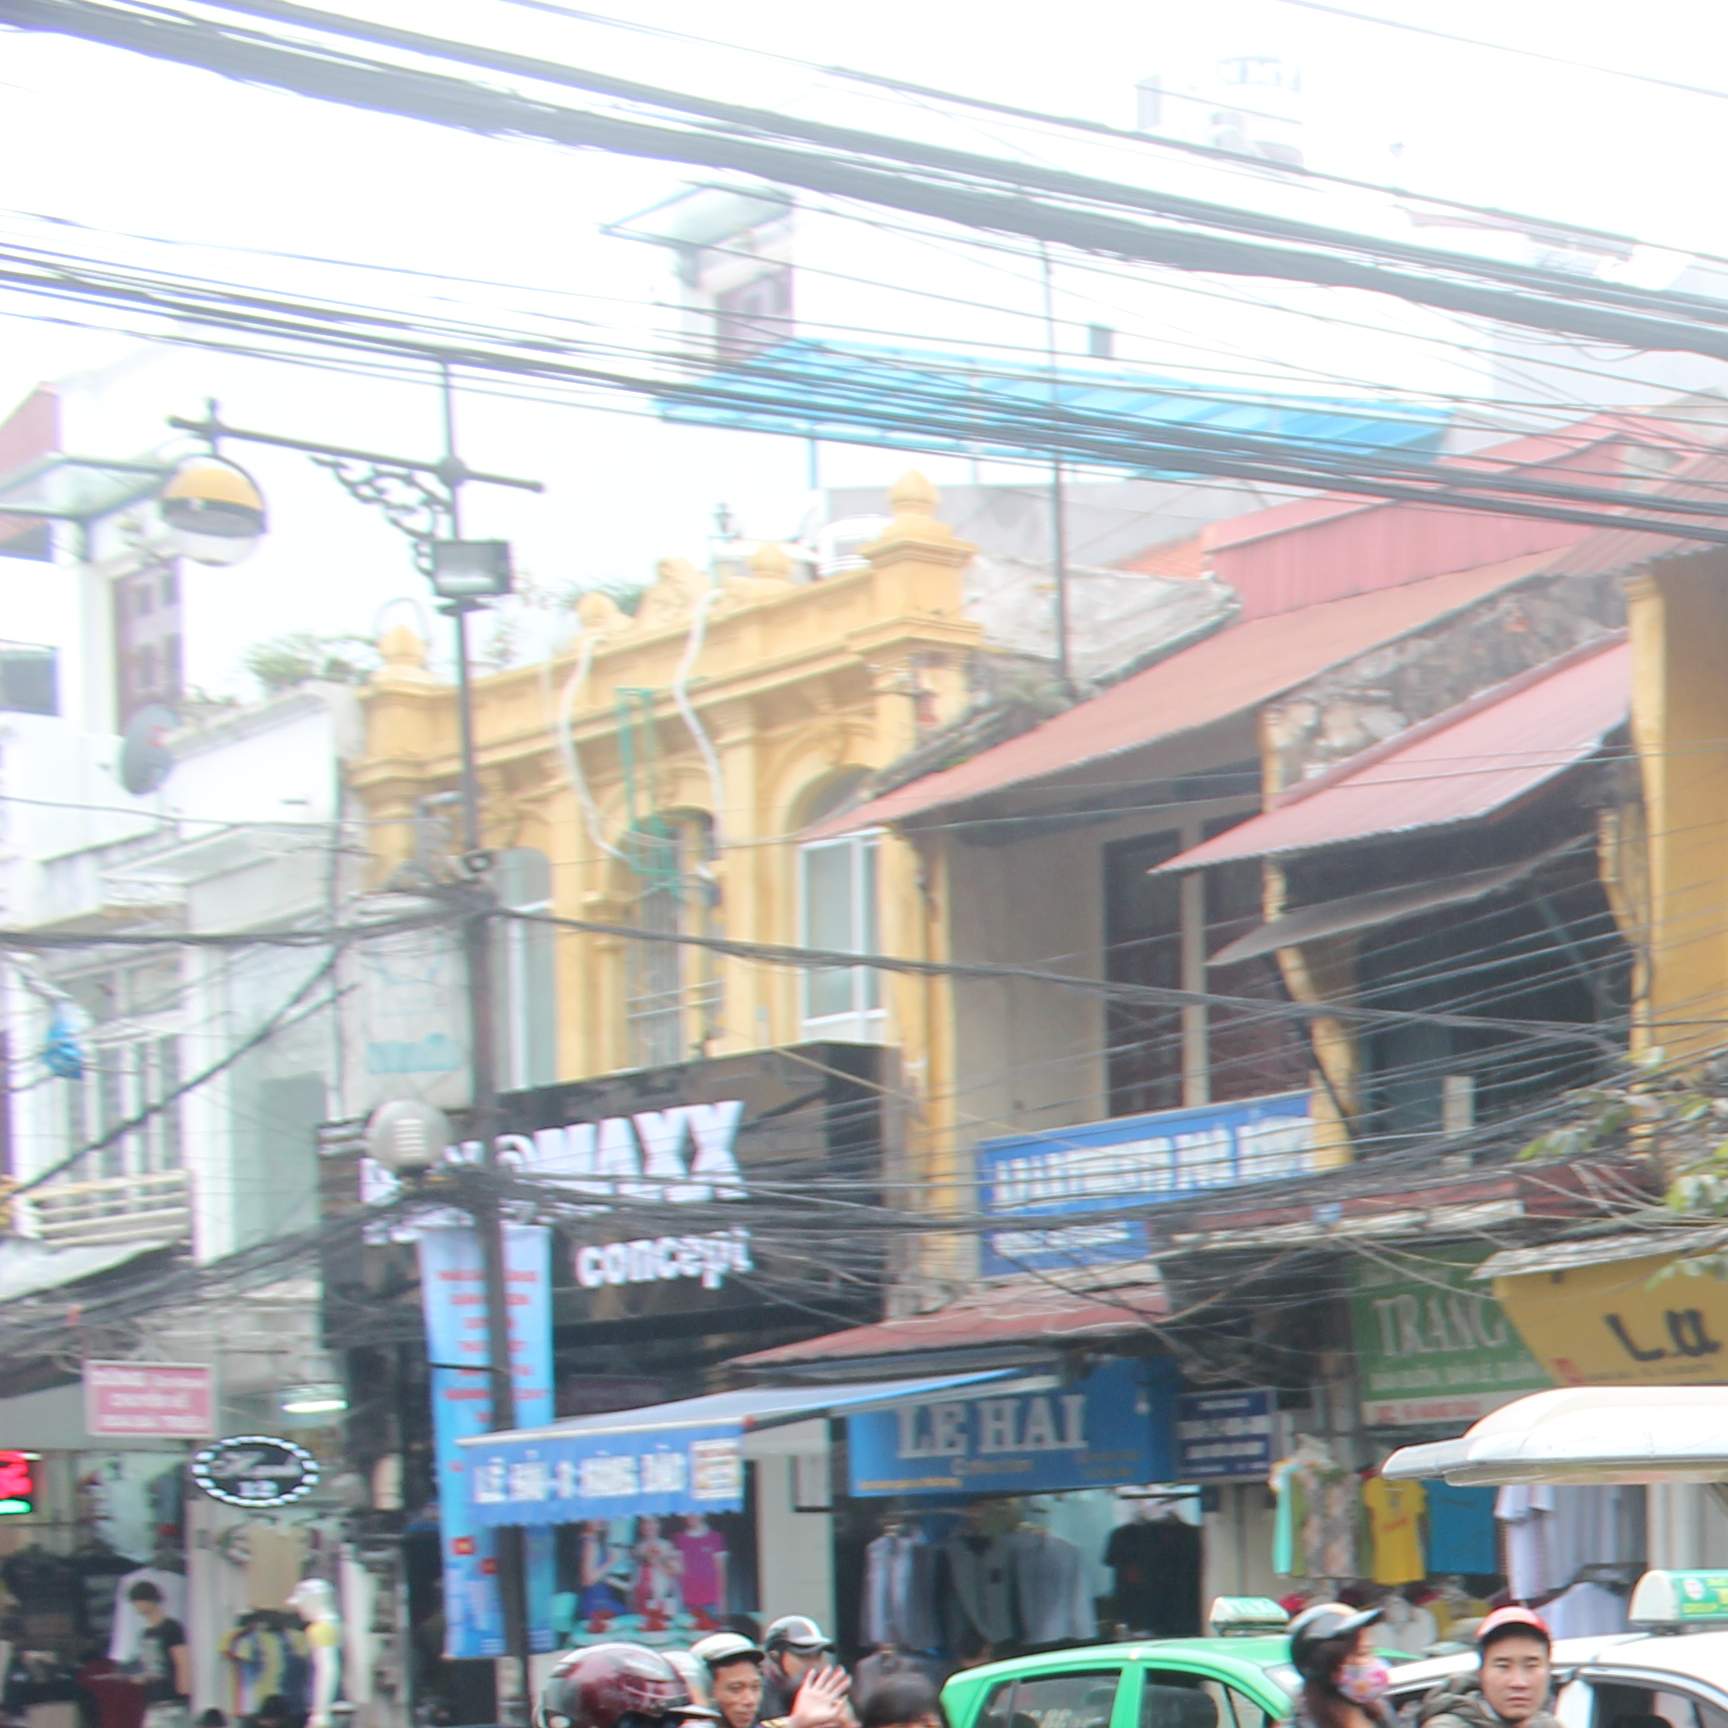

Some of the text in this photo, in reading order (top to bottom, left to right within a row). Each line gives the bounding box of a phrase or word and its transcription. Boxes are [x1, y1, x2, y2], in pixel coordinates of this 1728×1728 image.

[576, 1226, 754, 1289] concept
[1372, 1292, 1507, 1357] TRANG
[898, 1395, 1089, 1459] LE HAI
